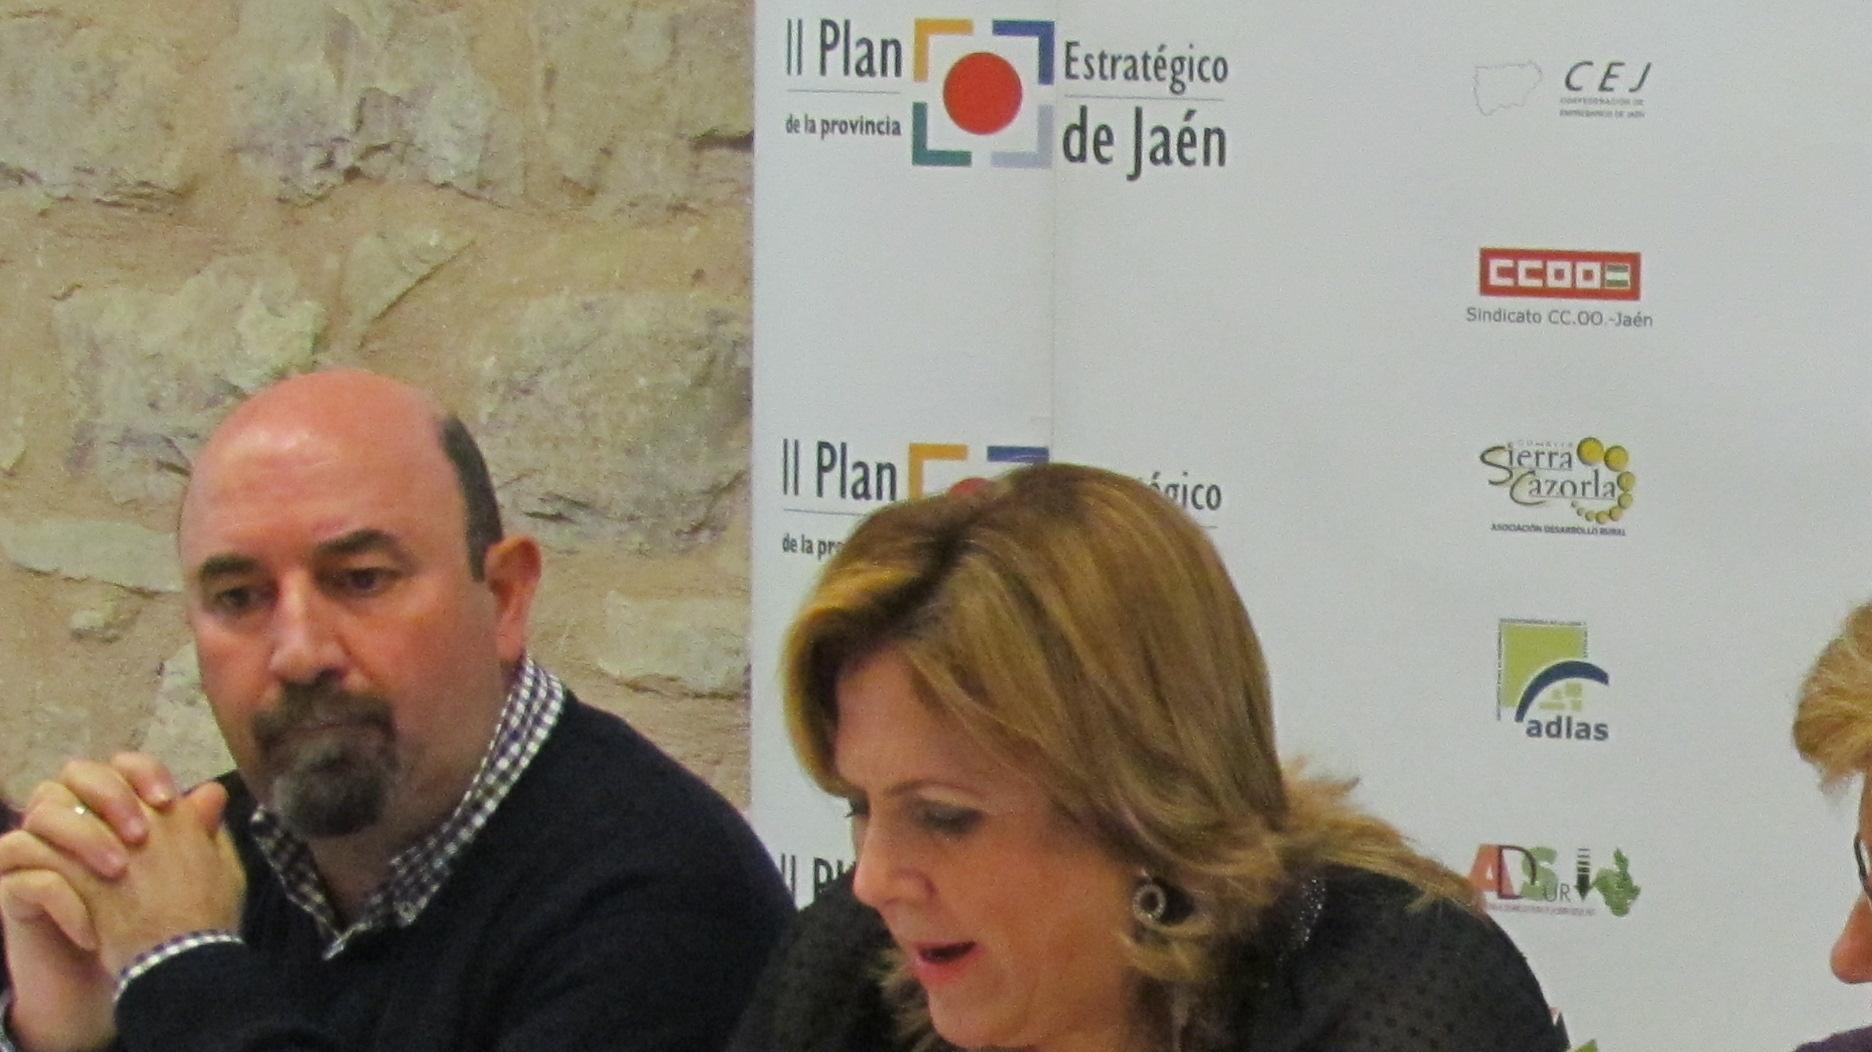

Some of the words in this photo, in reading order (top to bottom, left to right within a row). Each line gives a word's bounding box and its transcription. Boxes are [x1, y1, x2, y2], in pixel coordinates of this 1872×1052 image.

[819, 19, 902, 79] Plan
[1063, 40, 1228, 94] Estratégico
[785, 113, 800, 134] de
[804, 113, 816, 134] la
[820, 114, 901, 141] provincia
[1062, 105, 1114, 166] de
[1126, 106, 1227, 180] Jaén
[1488, 258, 1601, 289] CCOO
[1467, 307, 1542, 325] Sindicato
[816, 440, 897, 501] Plan
[1480, 442, 1572, 485] Sierra
[1510, 469, 1615, 506] Cazorla
[782, 533, 798, 553] de
[801, 534, 814, 554] la
[1526, 715, 1609, 740] adlas
